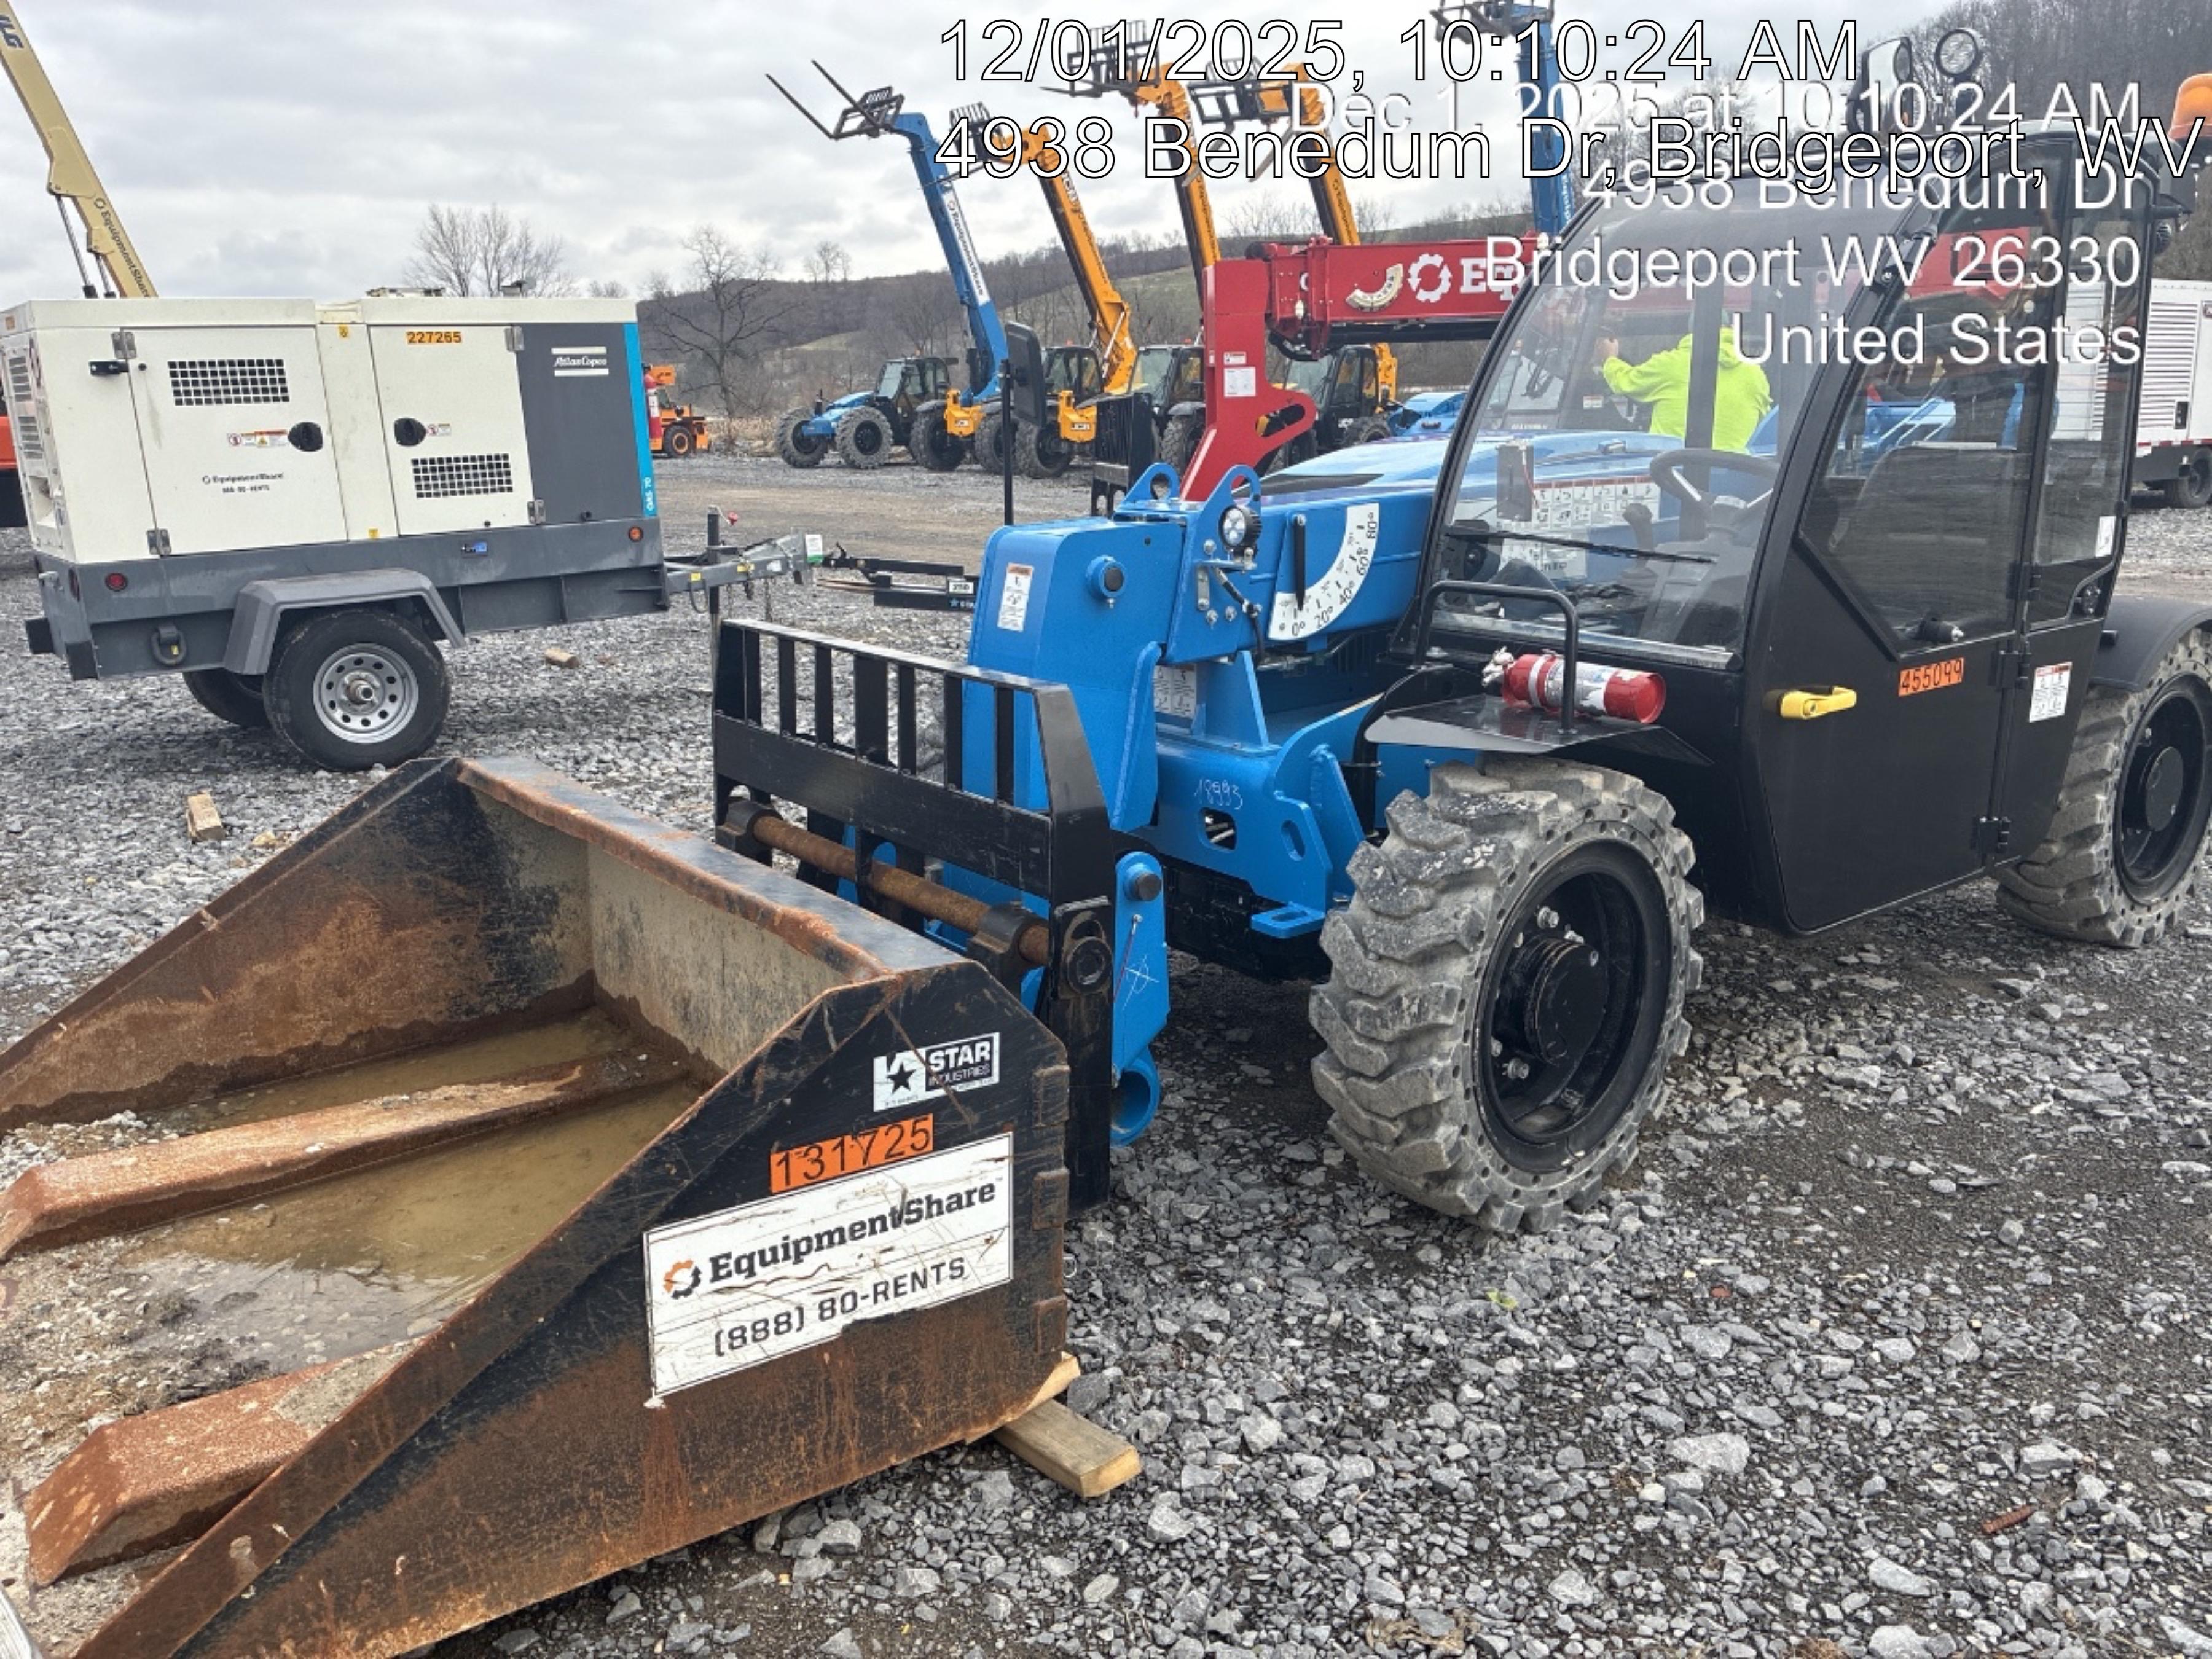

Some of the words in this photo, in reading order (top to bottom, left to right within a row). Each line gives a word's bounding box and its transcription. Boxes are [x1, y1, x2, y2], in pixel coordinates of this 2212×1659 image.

[407, 331, 462, 344] 227265
[1902, 659, 1962, 693] 455099
[928, 1041, 990, 1072] STAR
[775, 1116, 931, 1186] 131725
[709, 1182, 997, 1284] EquipmentShare
[714, 1306, 806, 1357] (888)
[818, 1257, 966, 1320] 80-RENTS
